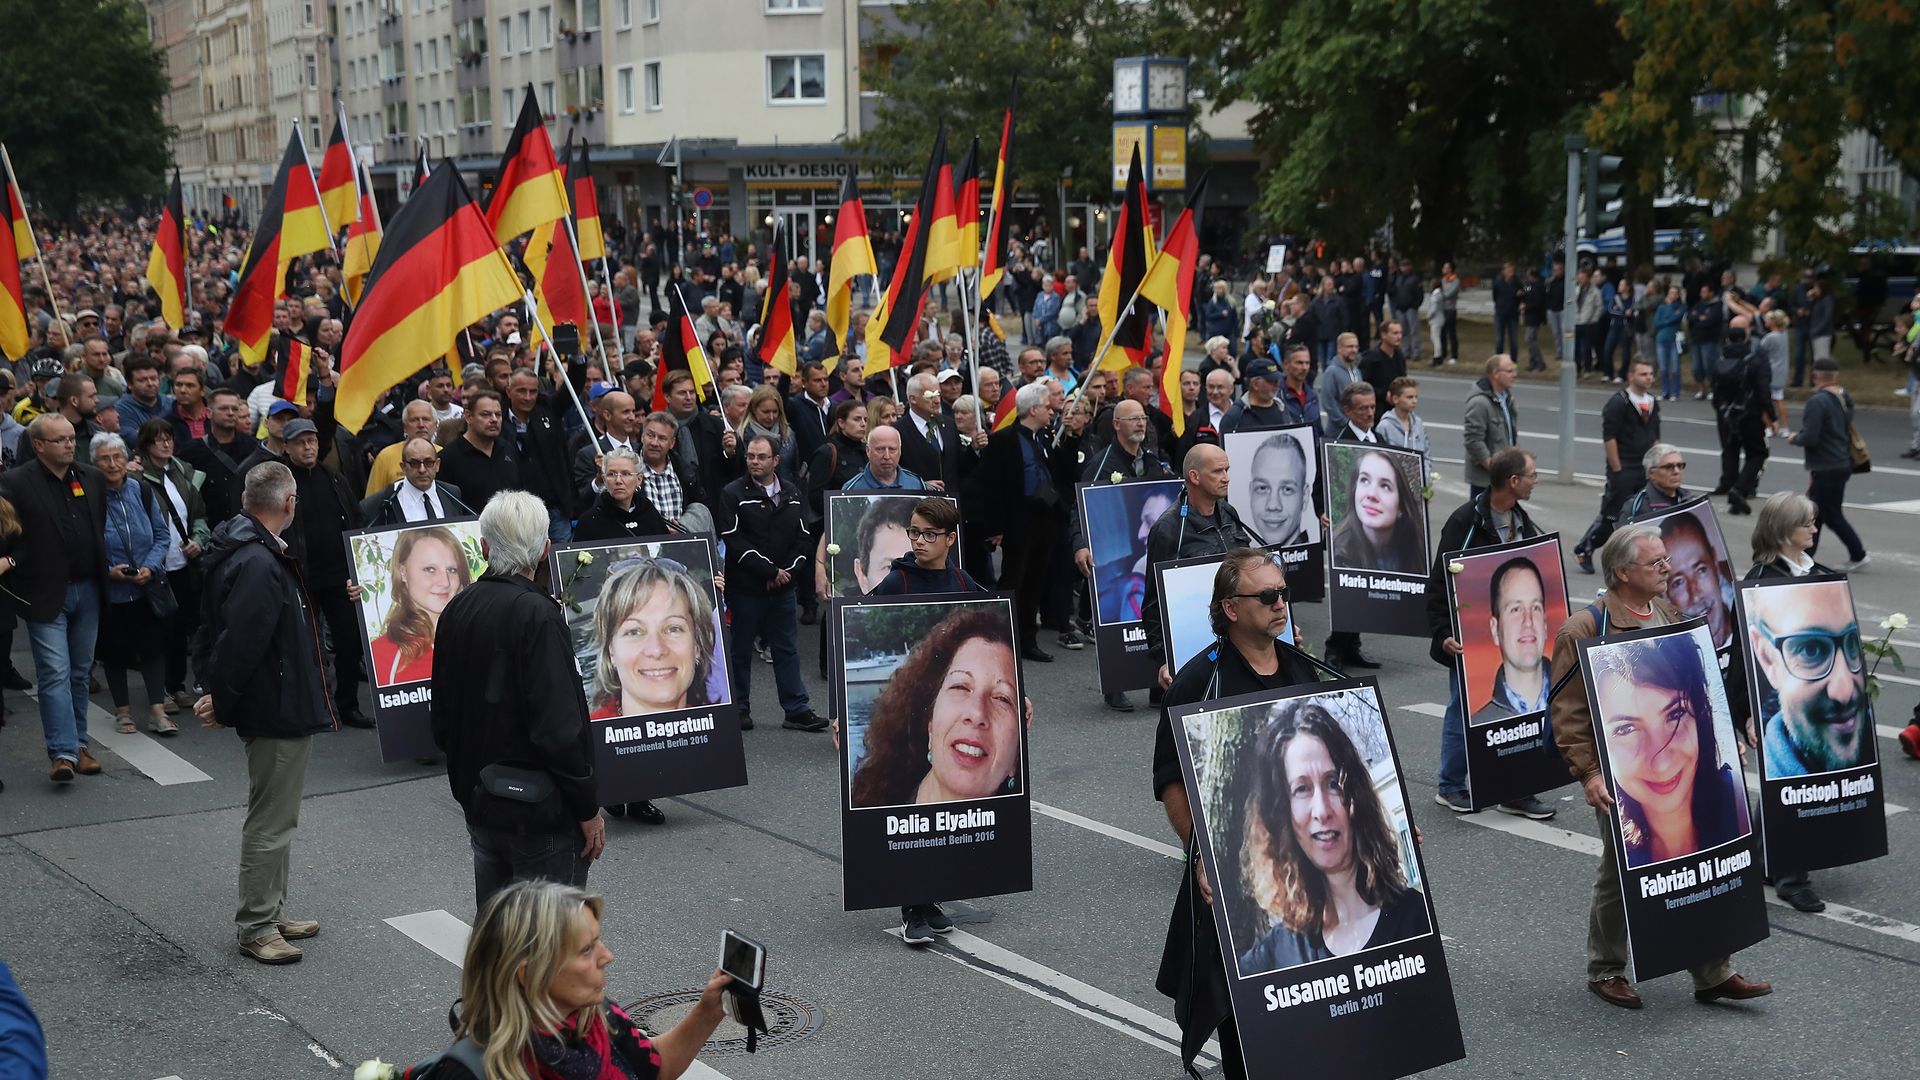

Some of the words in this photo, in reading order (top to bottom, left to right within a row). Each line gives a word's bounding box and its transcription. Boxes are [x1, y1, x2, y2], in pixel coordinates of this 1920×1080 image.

[746, 163, 788, 177] KULT
[1339, 573, 1367, 589] Maria
[1369, 575, 1425, 594] Ladenburger
[605, 726, 643, 744] Anna
[646, 713, 715, 738] Bagratuni
[1486, 721, 1540, 747] Sebastian
[615, 741, 665, 755] Terrorattentat
[667, 737, 689, 748] Berlin
[690, 734, 709, 745] 2016
[1780, 780, 1839, 805] Christoph
[886, 813, 930, 835] Dalia
[935, 807, 996, 832] Elyakim
[887, 836, 947, 850] Terrorattentat
[948, 833, 973, 845] Berlin
[974, 830, 995, 842] 2016
[1640, 866, 1697, 899] Fabrizia
[1698, 859, 1714, 883] Di
[1714, 849, 1752, 878] Lorenzo
[1263, 973, 1351, 1012] Susanne
[1353, 953, 1427, 991] Fontaine
[1329, 999, 1360, 1018] Berlin
[1361, 991, 1384, 1010] 2017
